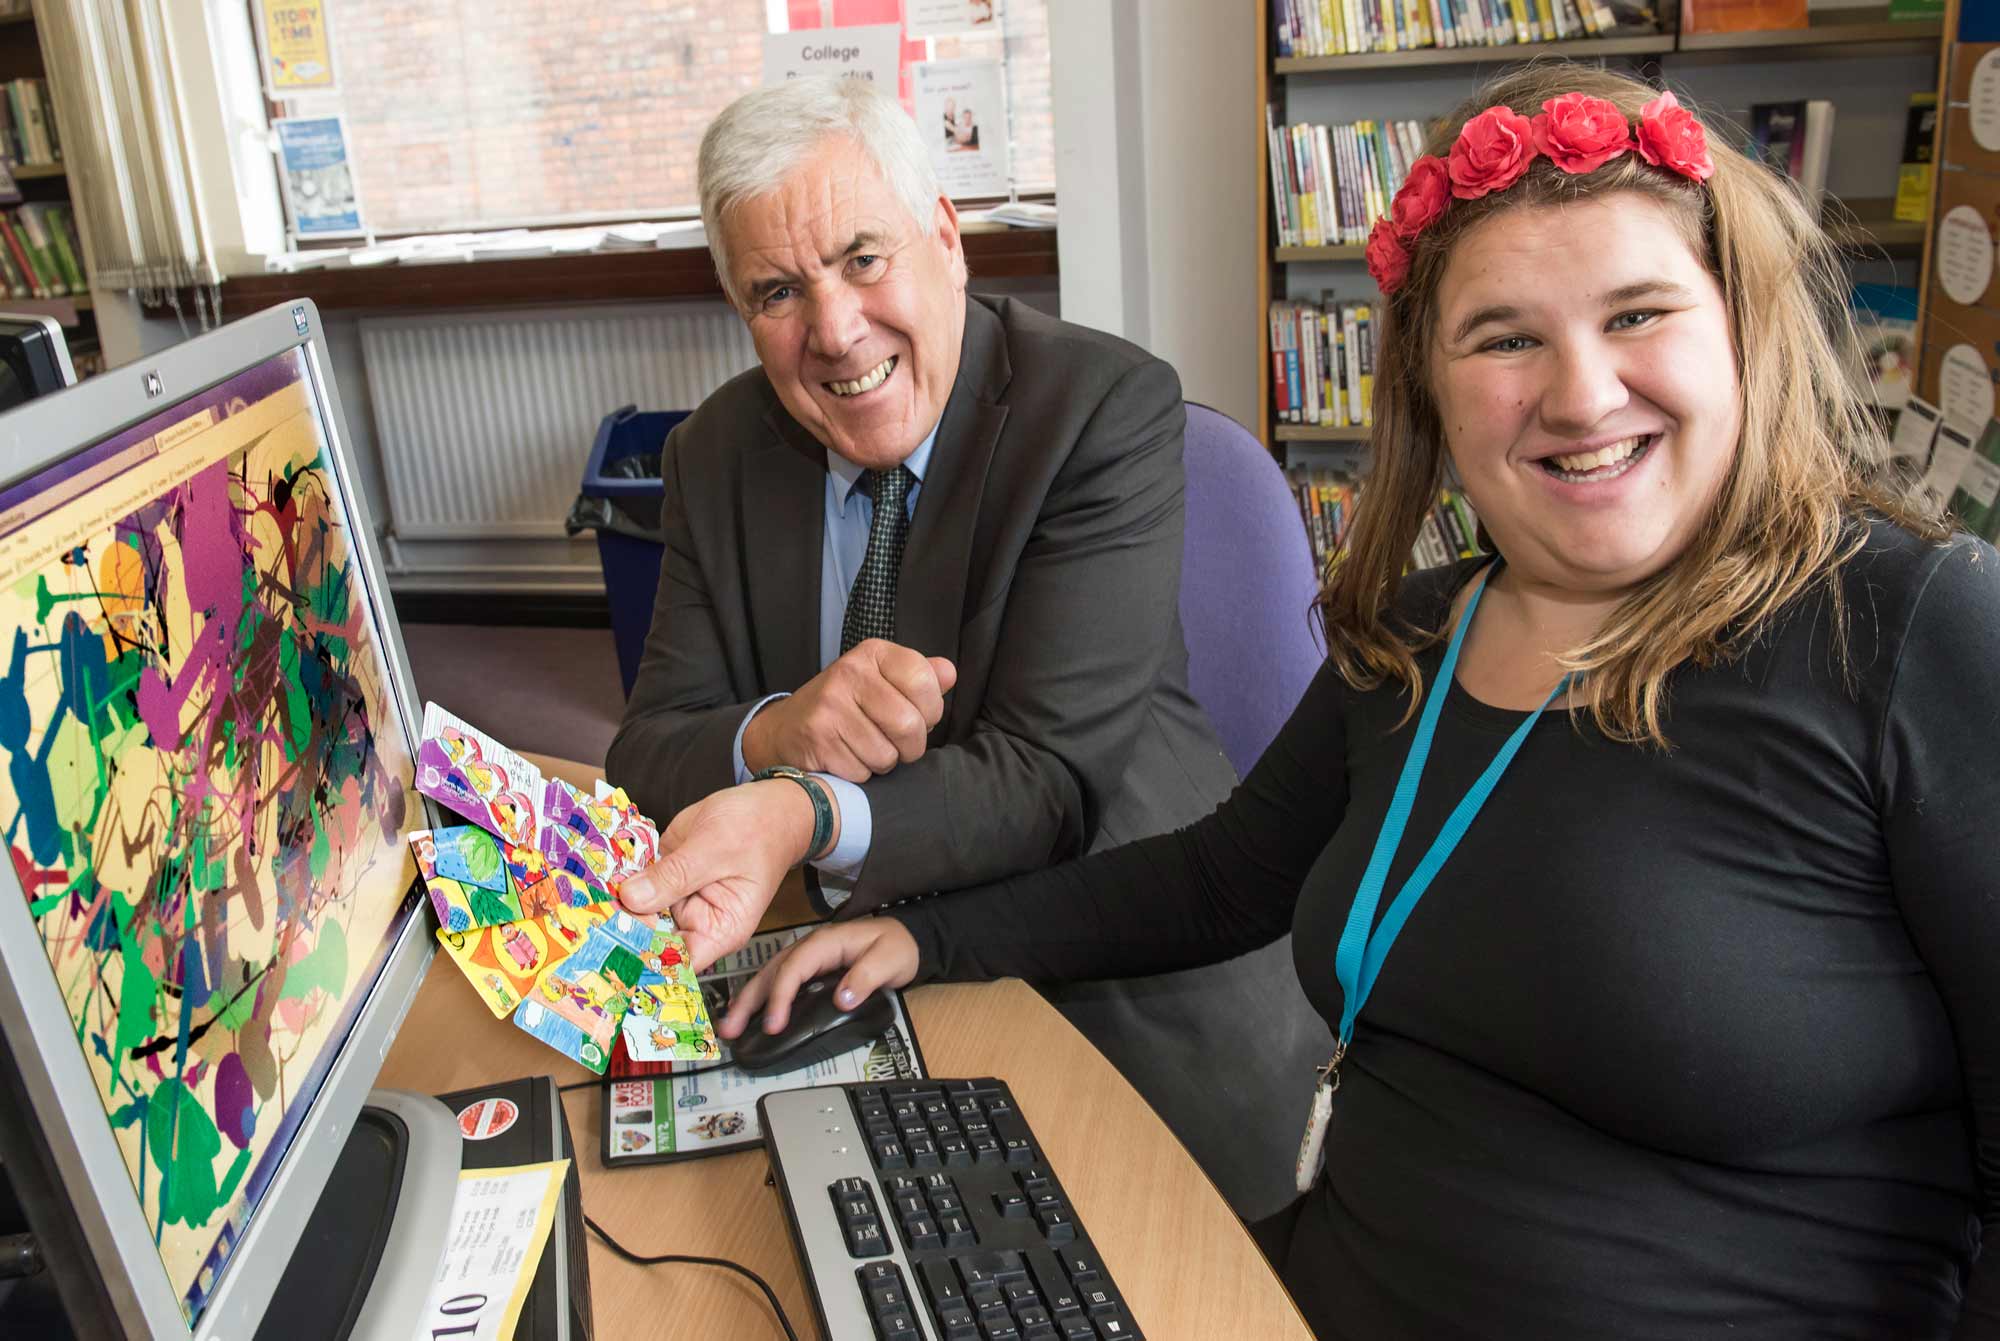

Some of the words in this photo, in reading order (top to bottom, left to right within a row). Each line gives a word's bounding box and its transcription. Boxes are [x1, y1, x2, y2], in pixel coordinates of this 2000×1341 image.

[801, 45, 860, 62] College
[630, 1081, 645, 1107] FOOD
[431, 1293, 488, 1341] 10
